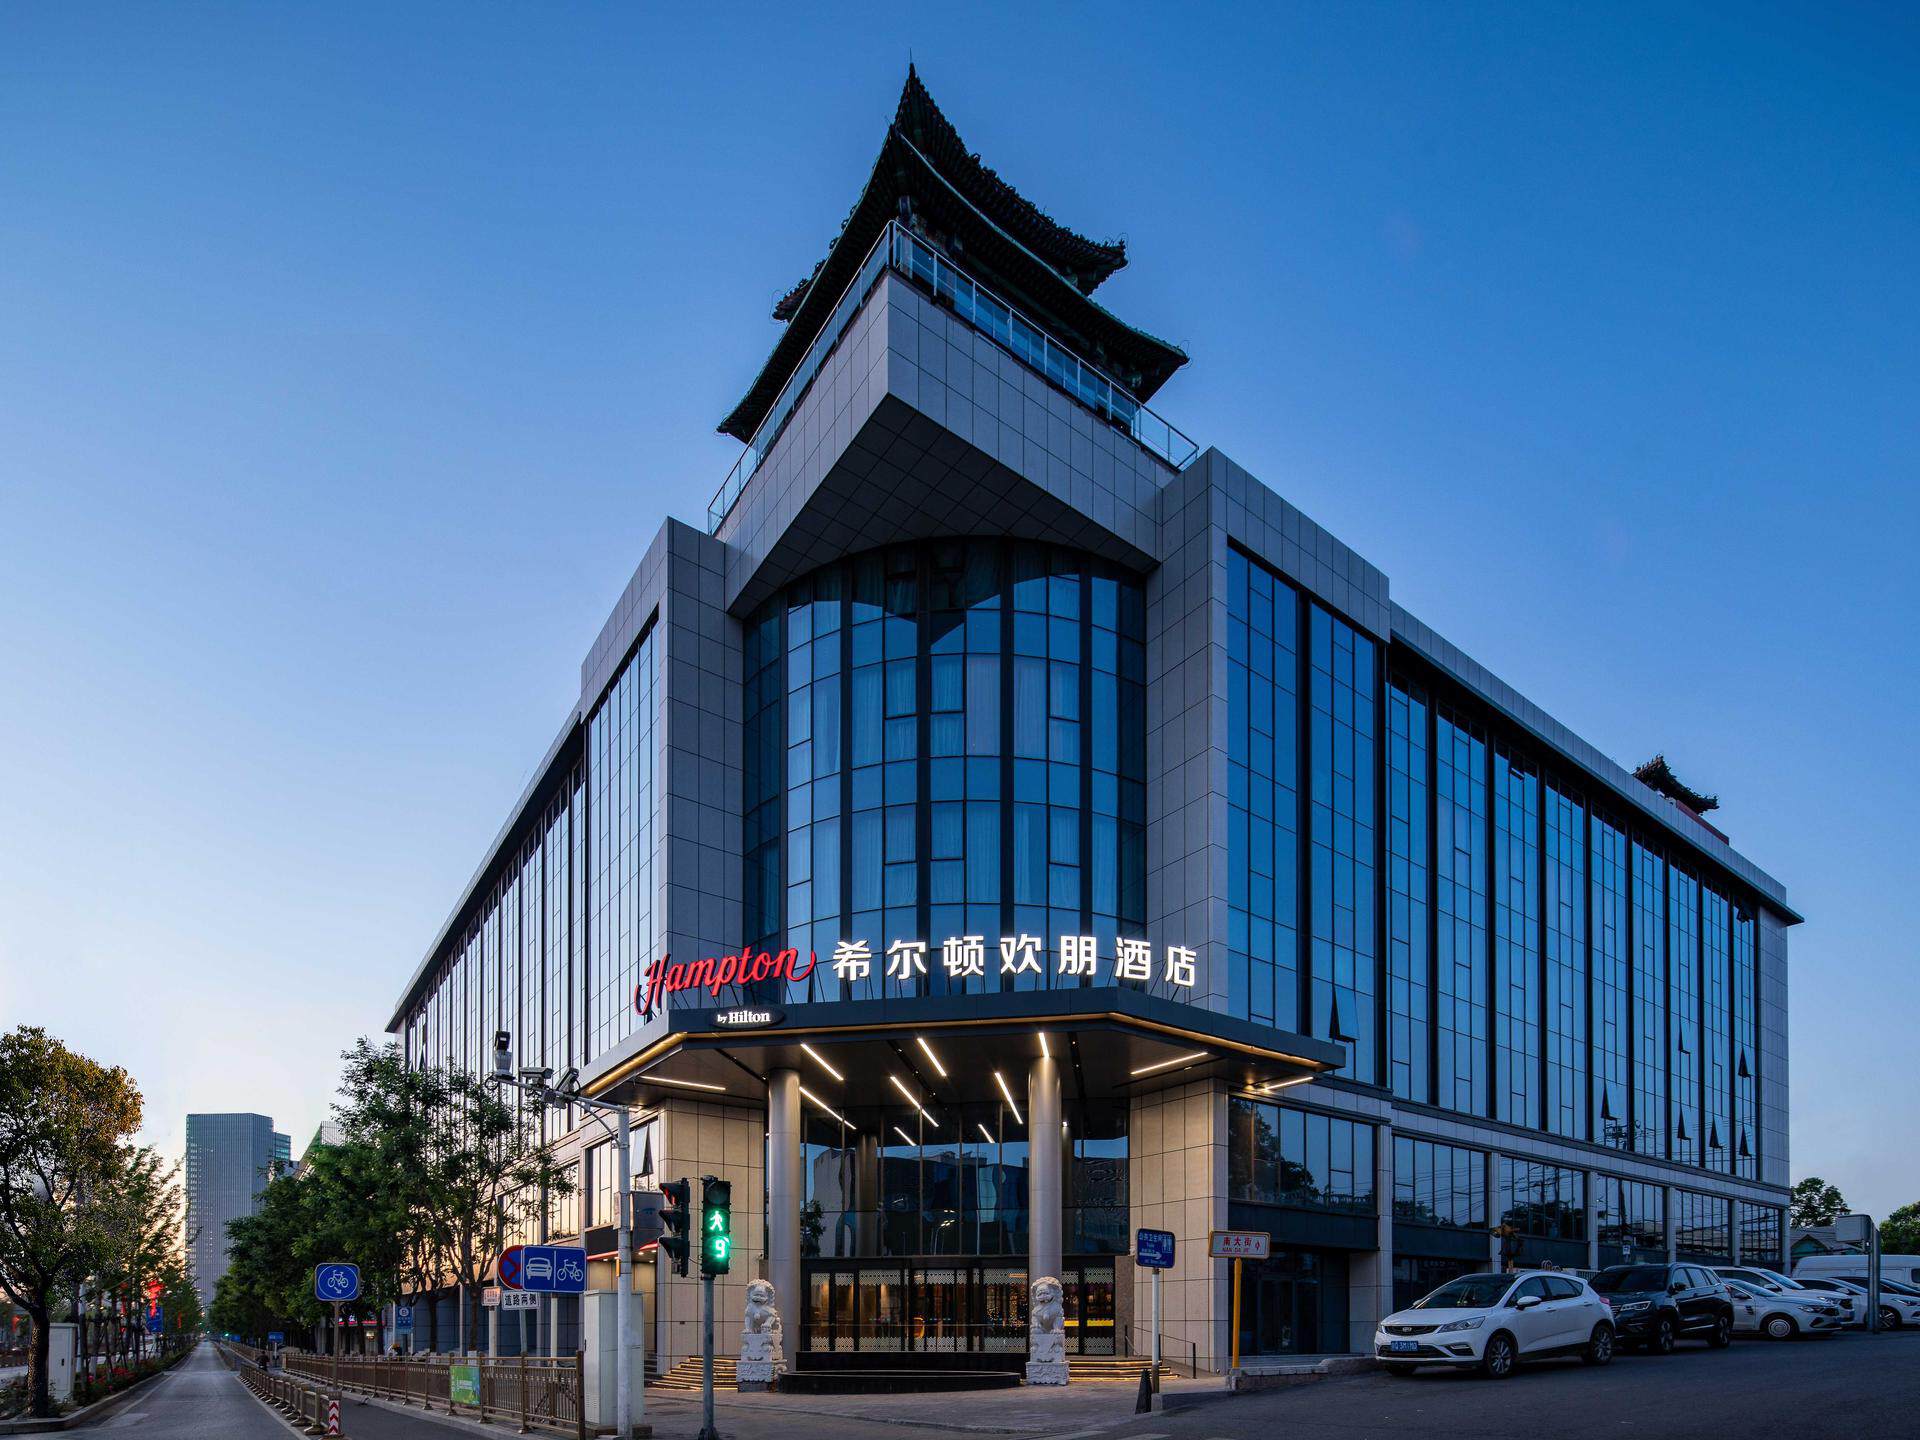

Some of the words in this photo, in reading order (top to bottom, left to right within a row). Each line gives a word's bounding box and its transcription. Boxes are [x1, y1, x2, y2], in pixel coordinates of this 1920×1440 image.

[832, 934, 1197, 987] 希尔顿欢朋酒店
[634, 946, 815, 1014] Hampton
[717, 1014, 727, 1023] by
[728, 1010, 771, 1023] Hilton
[715, 1239, 726, 1258] 9
[1223, 1236, 1252, 1246] 南大街
[504, 1293, 537, 1306] 道路两侧
